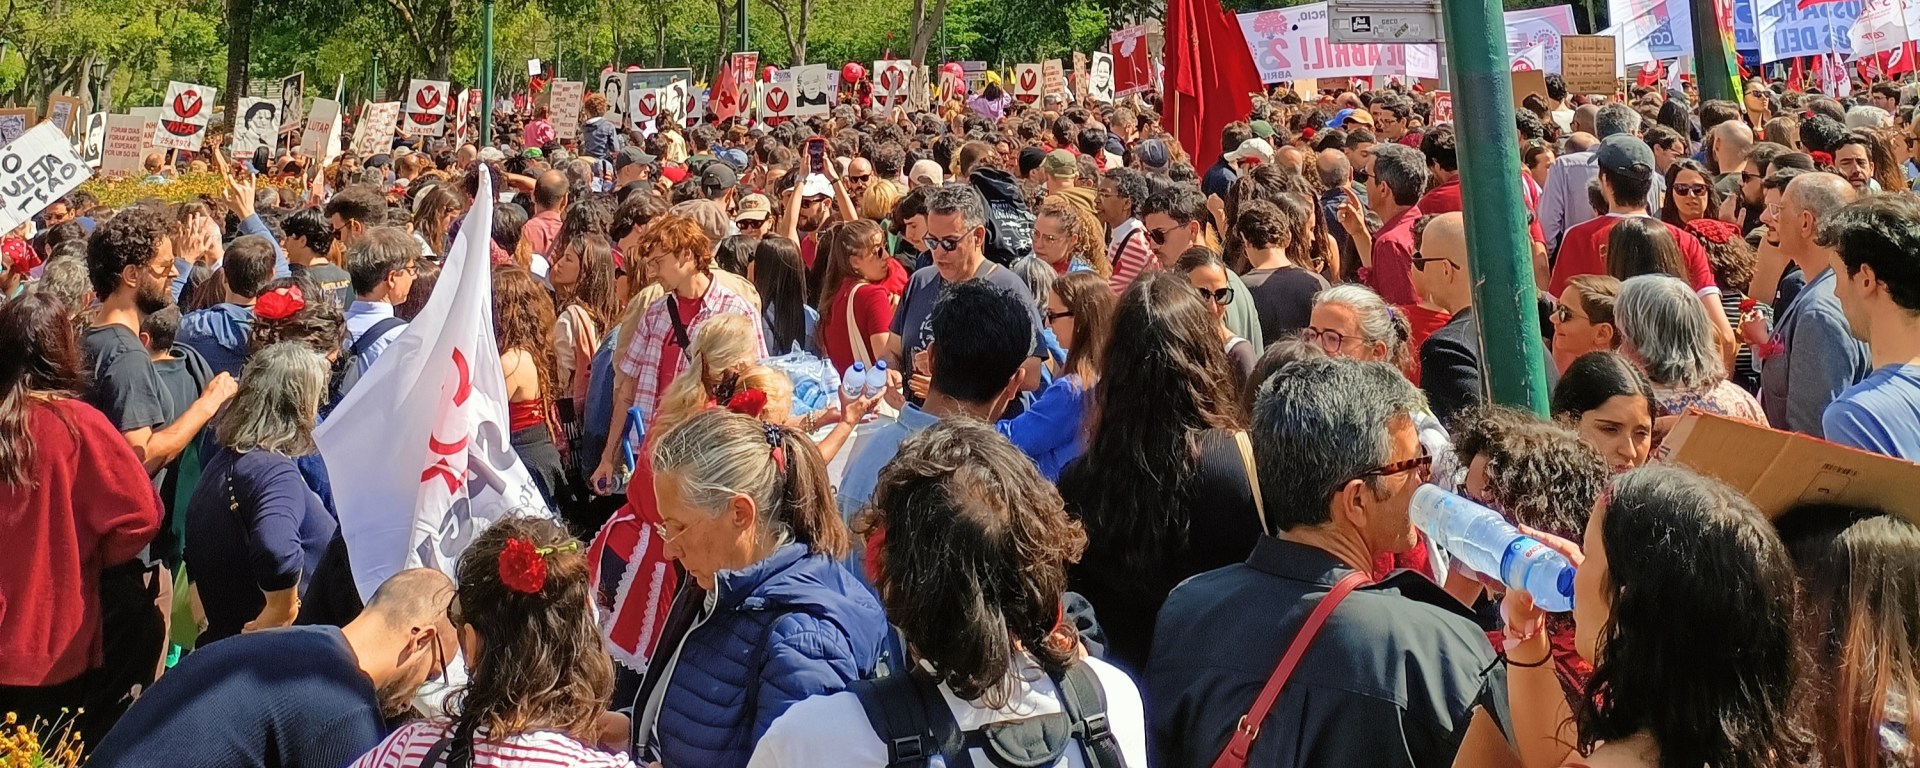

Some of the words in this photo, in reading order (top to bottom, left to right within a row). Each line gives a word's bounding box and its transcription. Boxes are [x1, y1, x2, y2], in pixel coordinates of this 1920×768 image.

[167, 122, 195, 134] MFA
[308, 120, 330, 134] LUTAR
[160, 137, 192, 149] 25.4.1974
